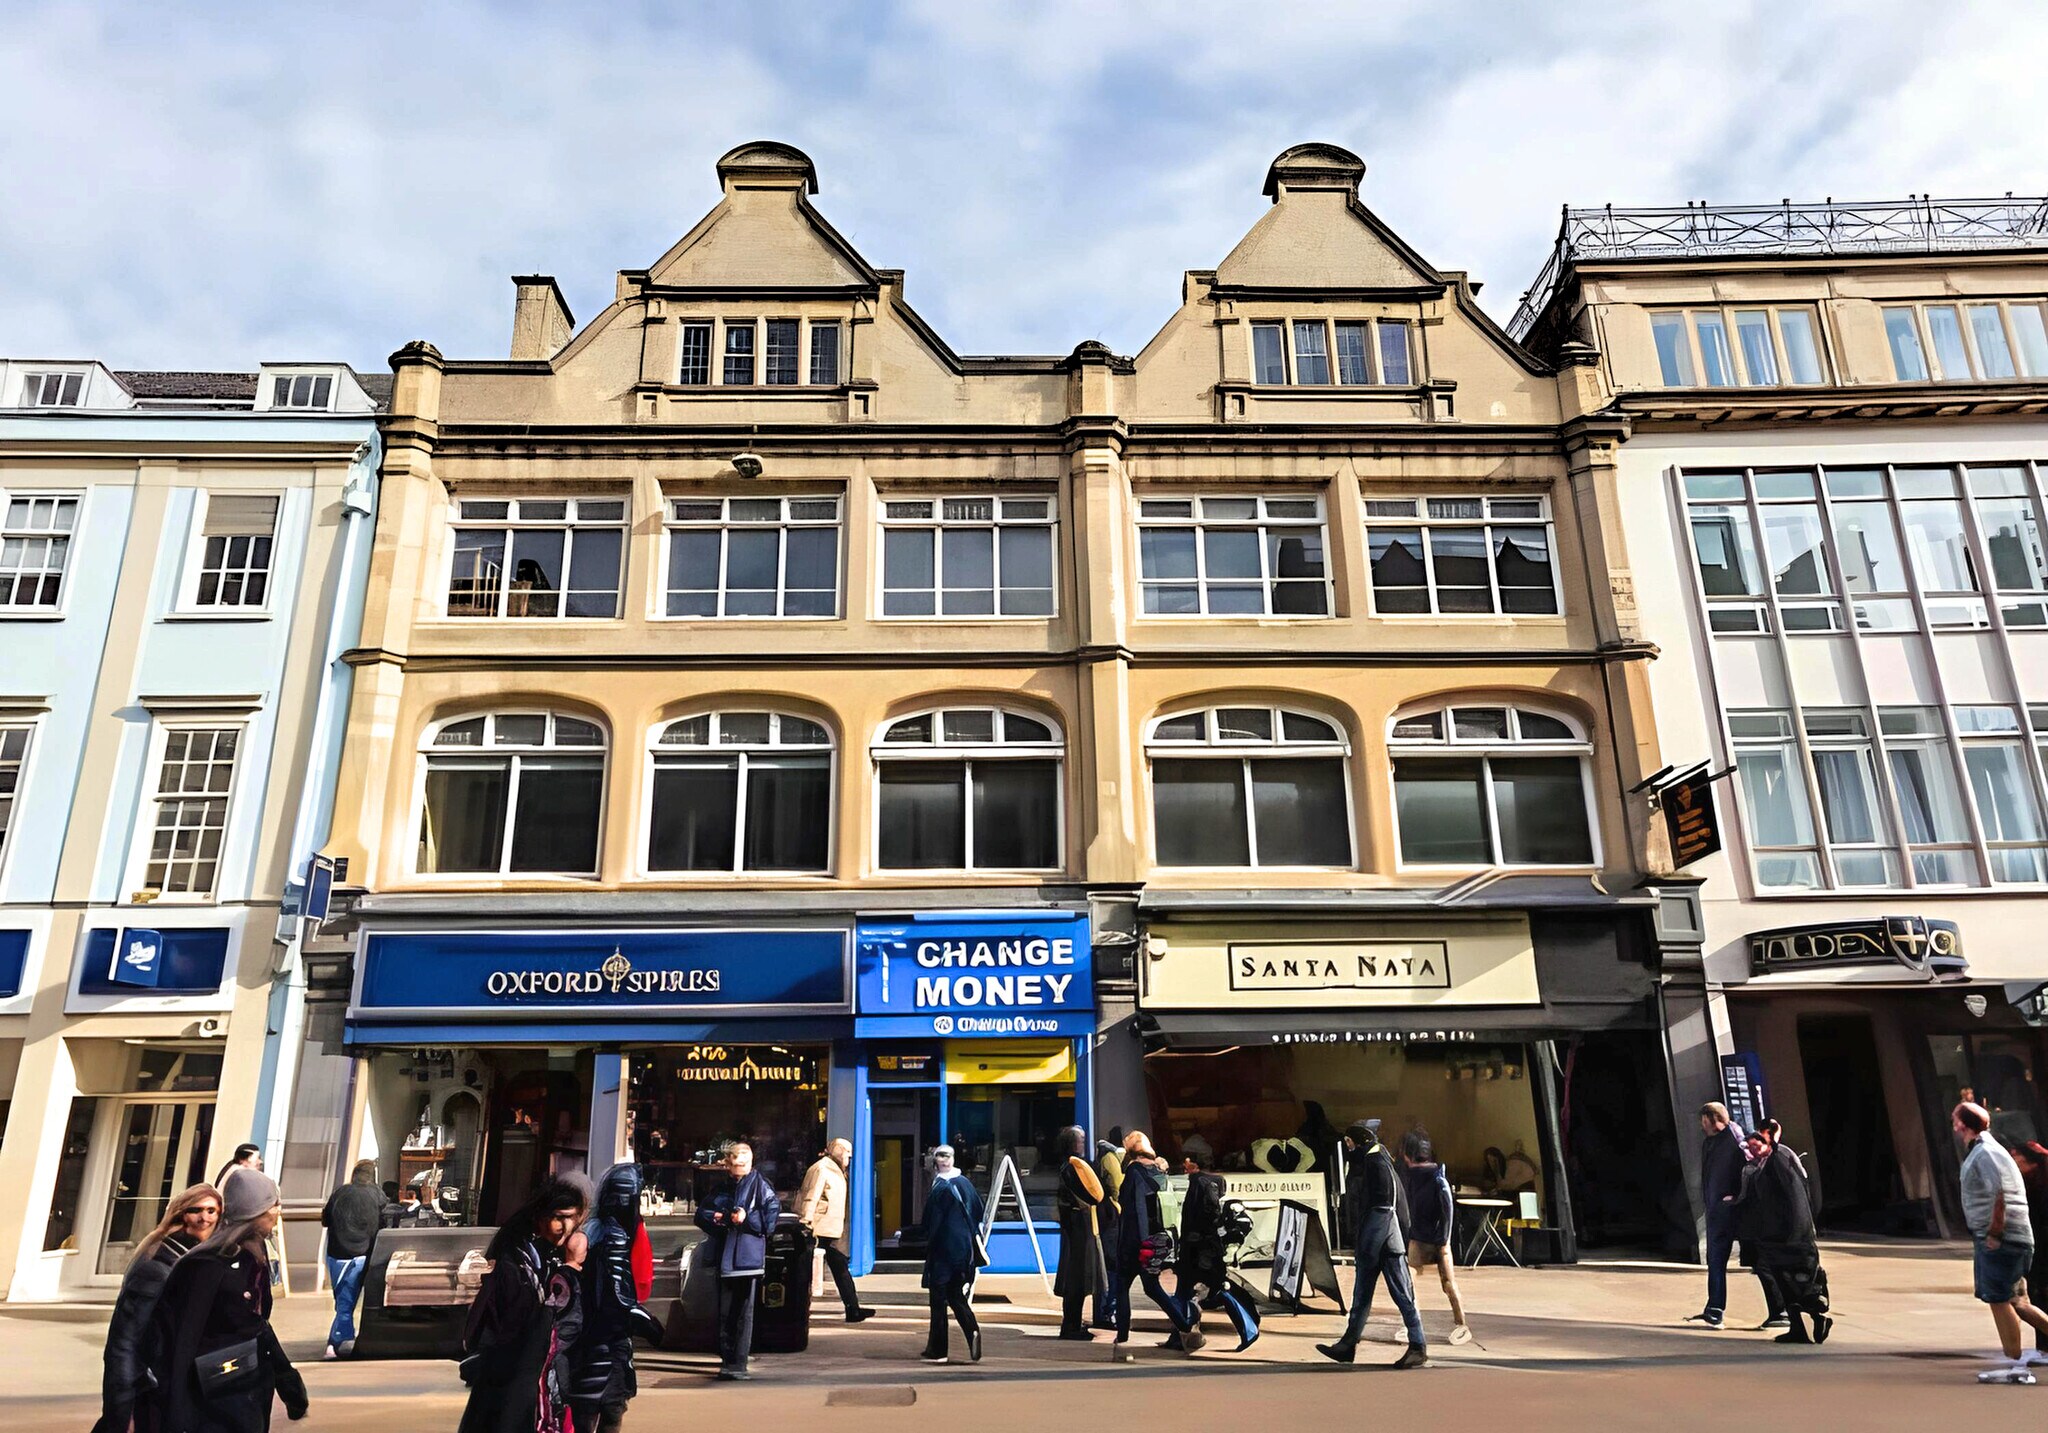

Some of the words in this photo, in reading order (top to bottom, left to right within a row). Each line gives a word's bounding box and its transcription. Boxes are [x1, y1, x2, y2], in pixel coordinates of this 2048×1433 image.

[916, 938, 1075, 968] CHANGE
[1240, 956, 1340, 978] SANTA
[486, 970, 603, 996] OXFORD
[915, 973, 1074, 1008] MONEY
